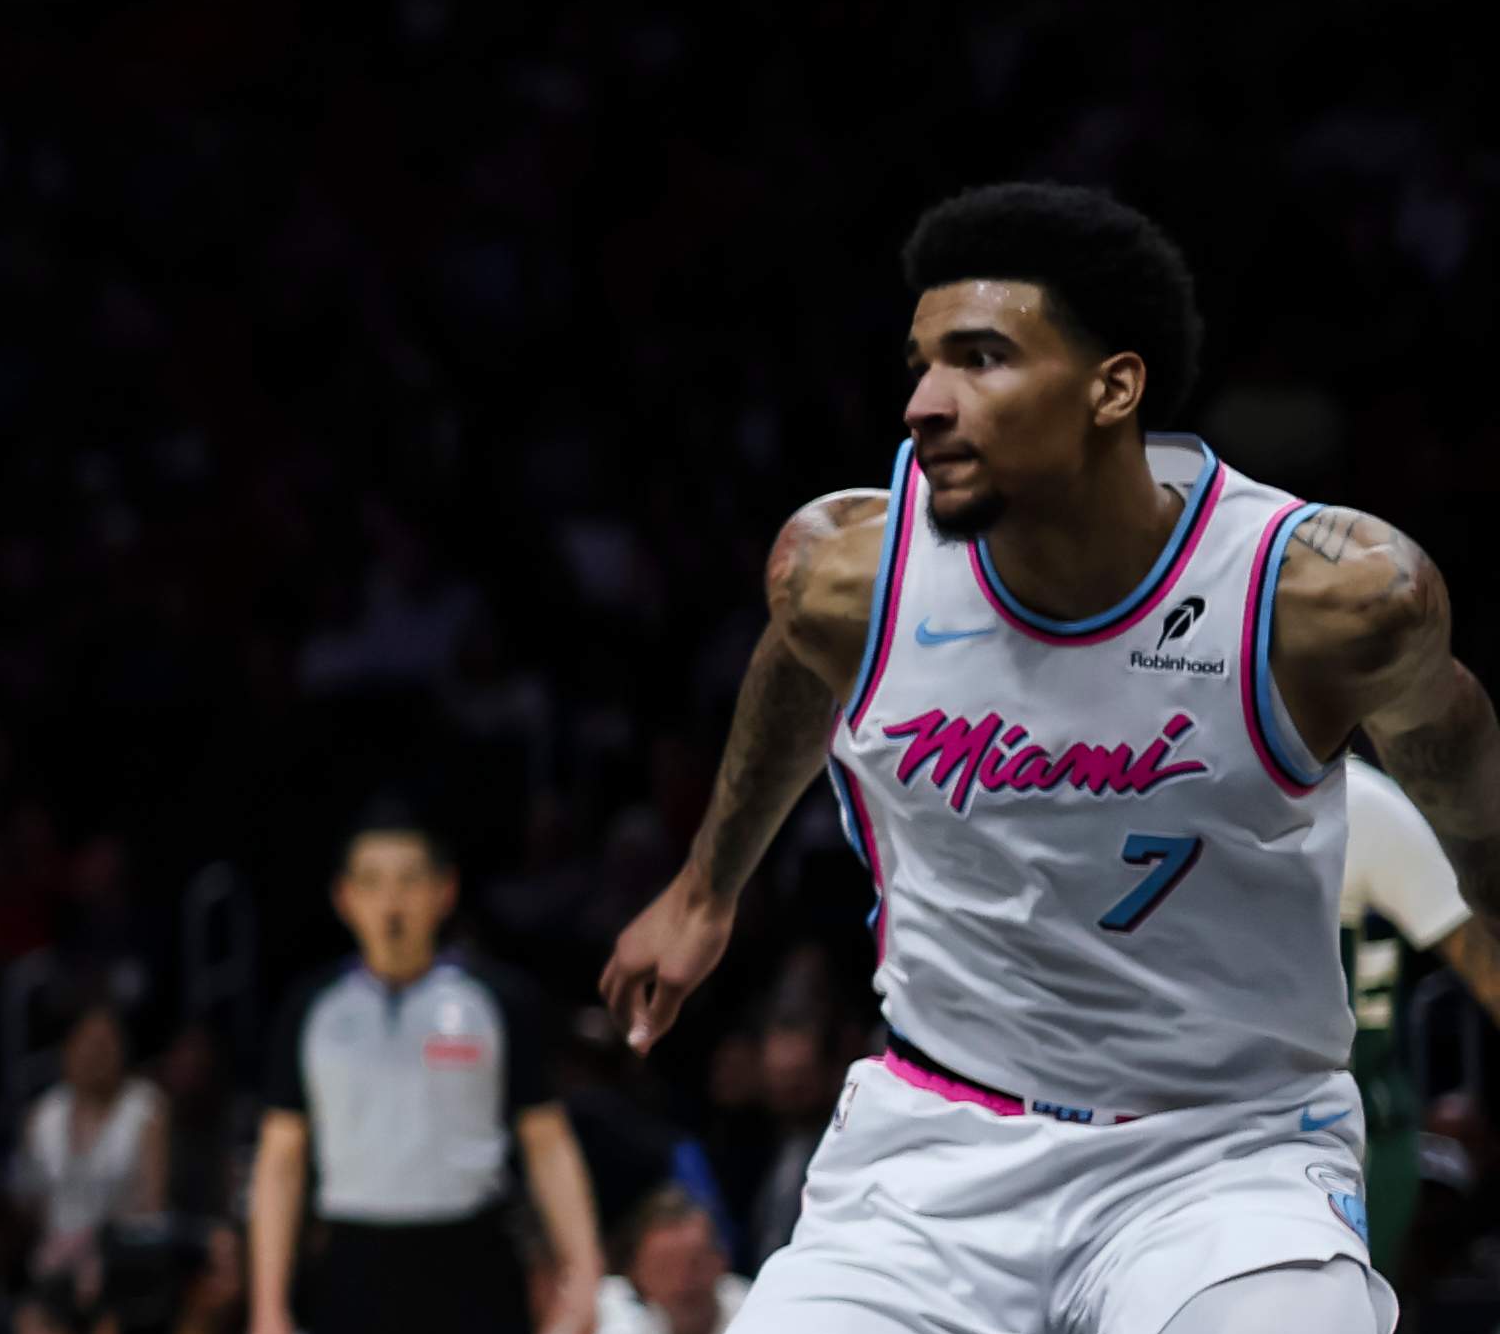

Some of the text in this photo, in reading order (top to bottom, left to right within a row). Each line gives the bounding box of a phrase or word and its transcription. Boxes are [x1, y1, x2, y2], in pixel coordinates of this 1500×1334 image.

[1130, 650, 1224, 675] Robinhood
[884, 709, 1208, 813] Miami
[1098, 834, 1204, 934] 7
